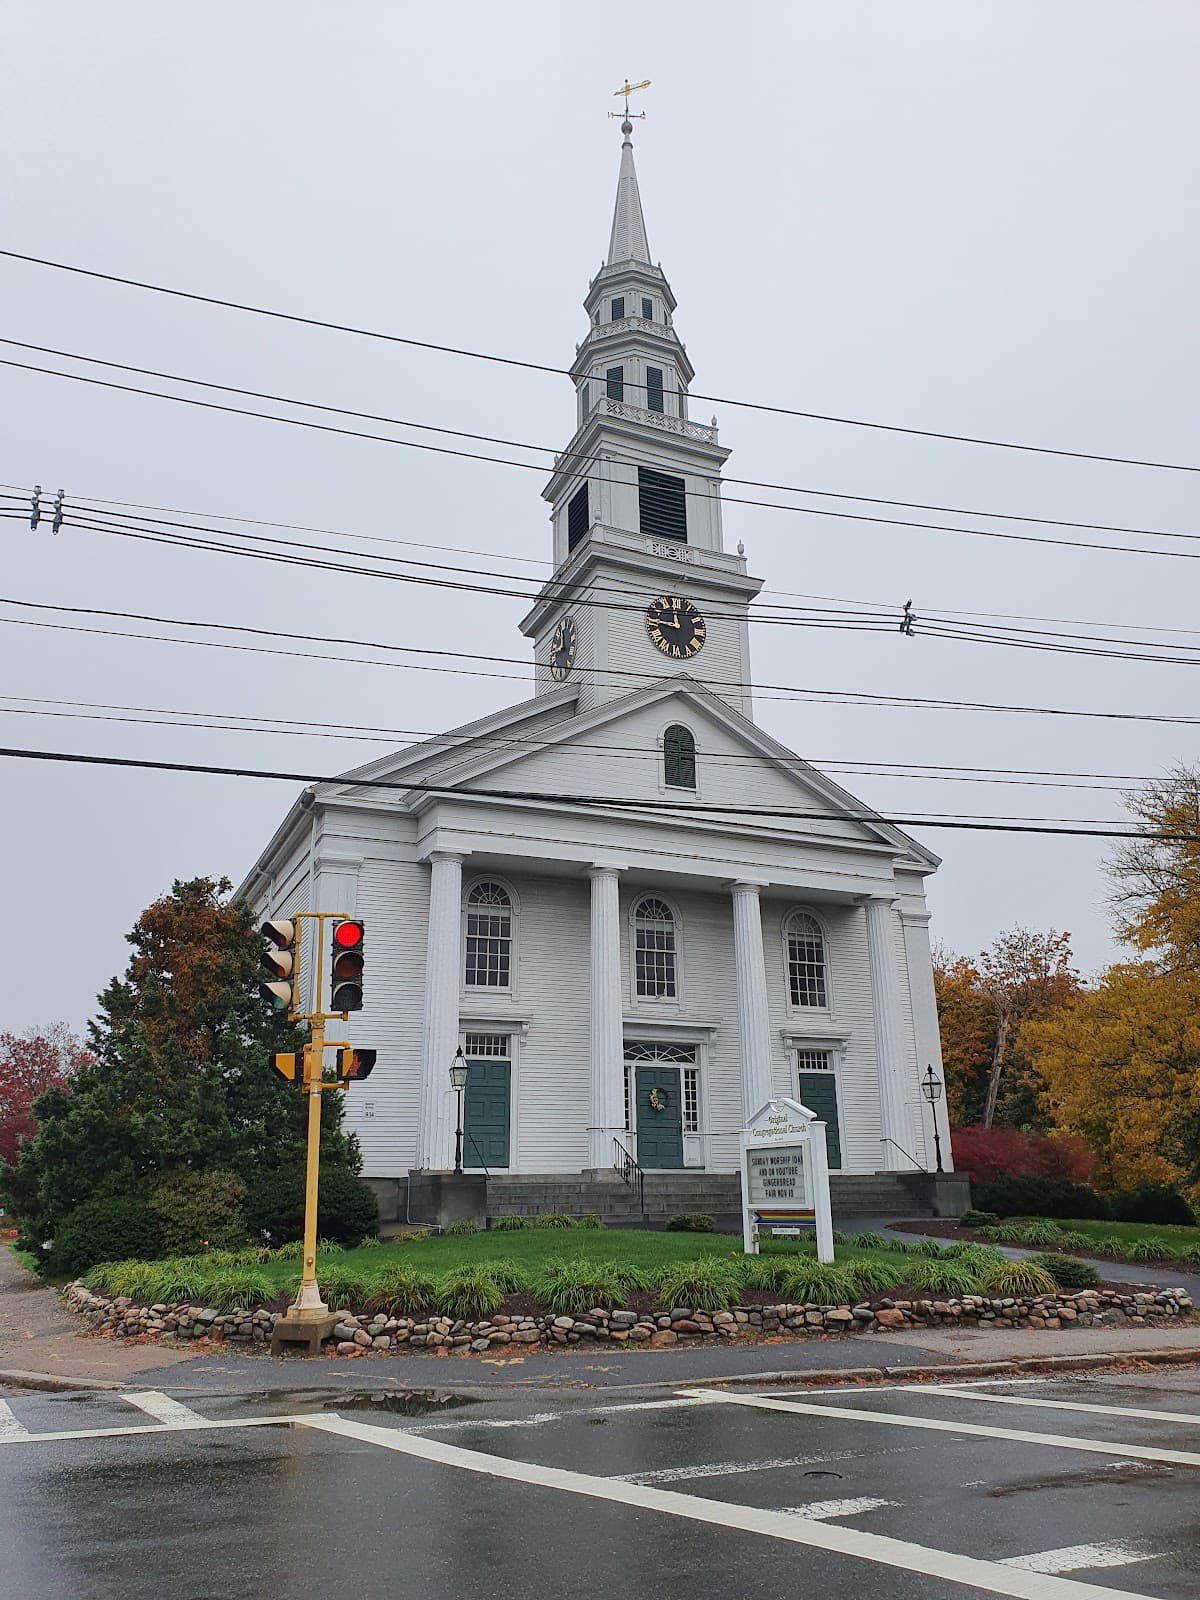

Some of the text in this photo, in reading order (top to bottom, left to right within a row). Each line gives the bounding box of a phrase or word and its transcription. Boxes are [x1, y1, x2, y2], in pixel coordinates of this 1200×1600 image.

[768, 1113, 788, 1125] Original
[752, 1122, 807, 1138] Congregational Church
[752, 1157, 768, 1166] SUNDAY
[770, 1156, 790, 1165] WORSHIP
[759, 1168, 767, 1176] AND
[775, 1166, 798, 1176] YOUTUBE
[763, 1178, 795, 1187] GINGERBREAD
[765, 1189, 776, 1198] FAIR
[777, 1189, 787, 1198] NOV
